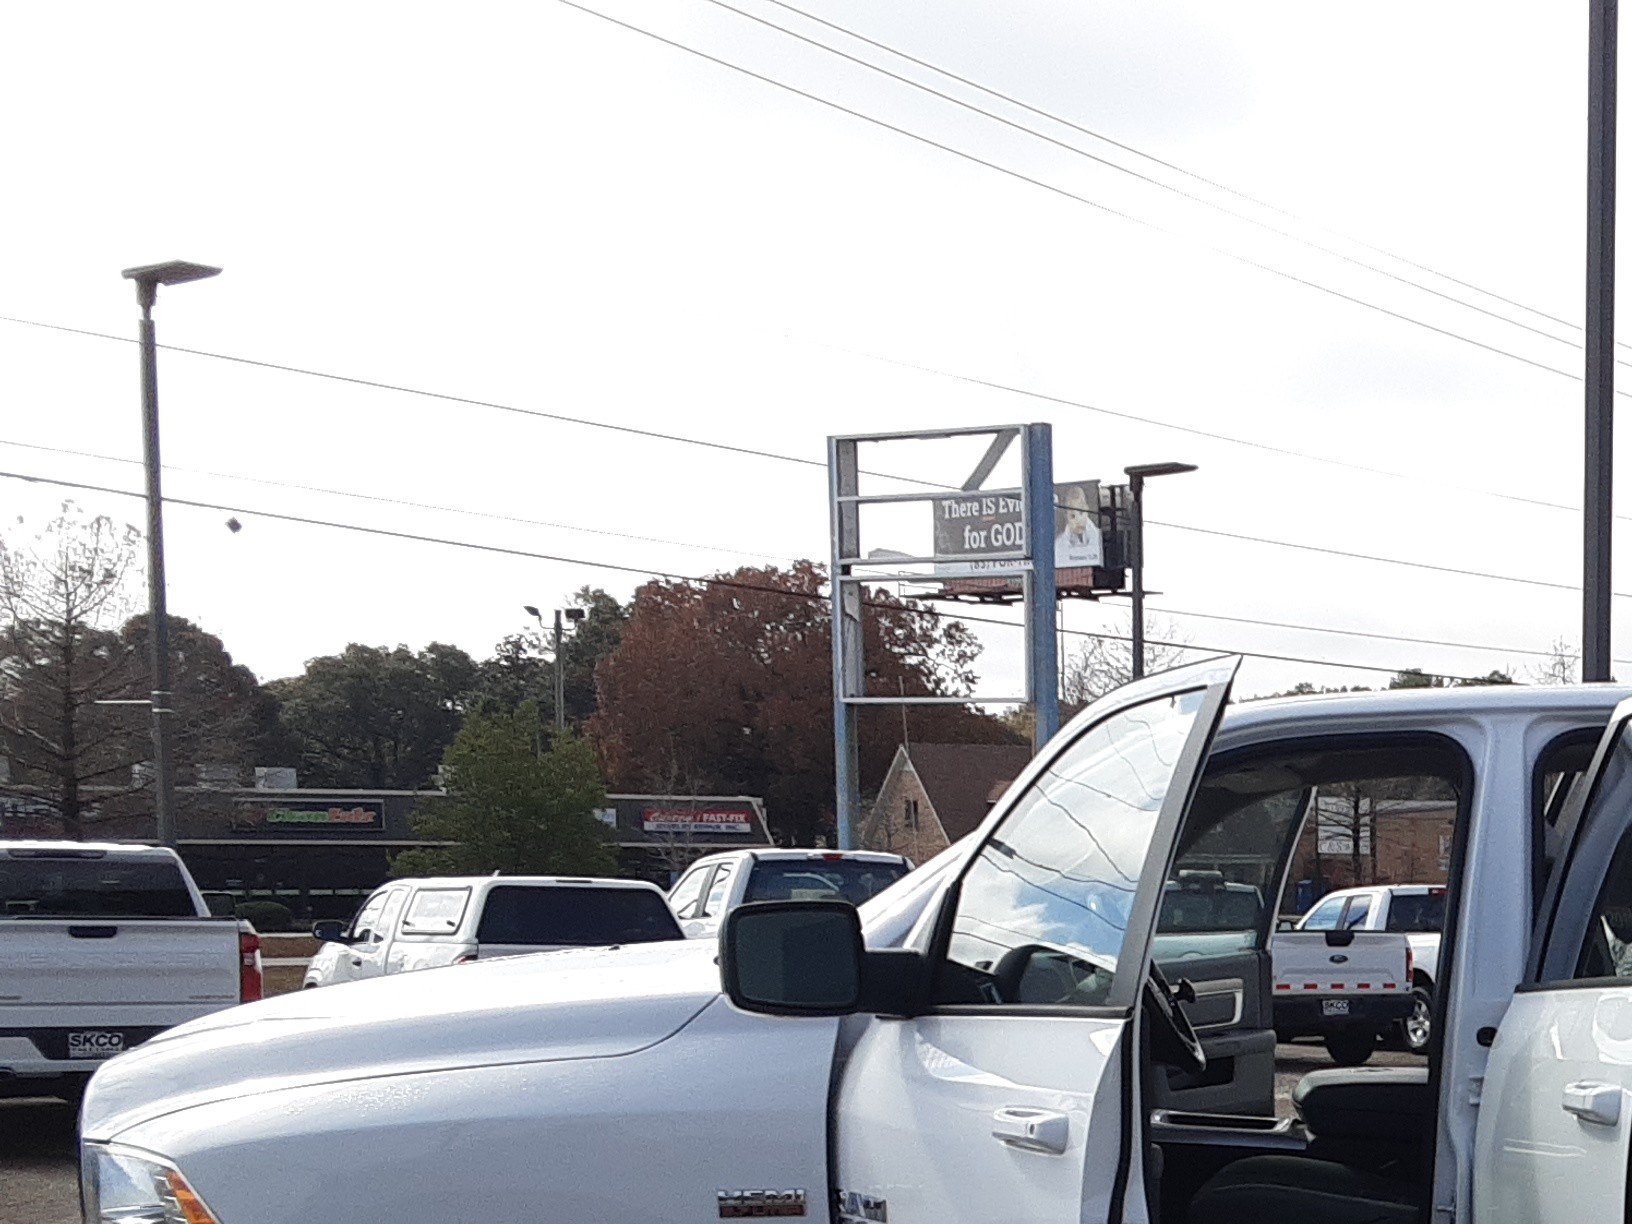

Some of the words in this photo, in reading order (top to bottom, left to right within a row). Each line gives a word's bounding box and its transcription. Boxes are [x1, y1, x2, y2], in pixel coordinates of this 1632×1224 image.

[942, 499, 979, 518] There
[982, 497, 996, 515] IS
[998, 497, 1024, 513] Evi
[964, 525, 987, 549] for
[991, 522, 1025, 546] GOD
[70, 1034, 122, 1047] SKCO
